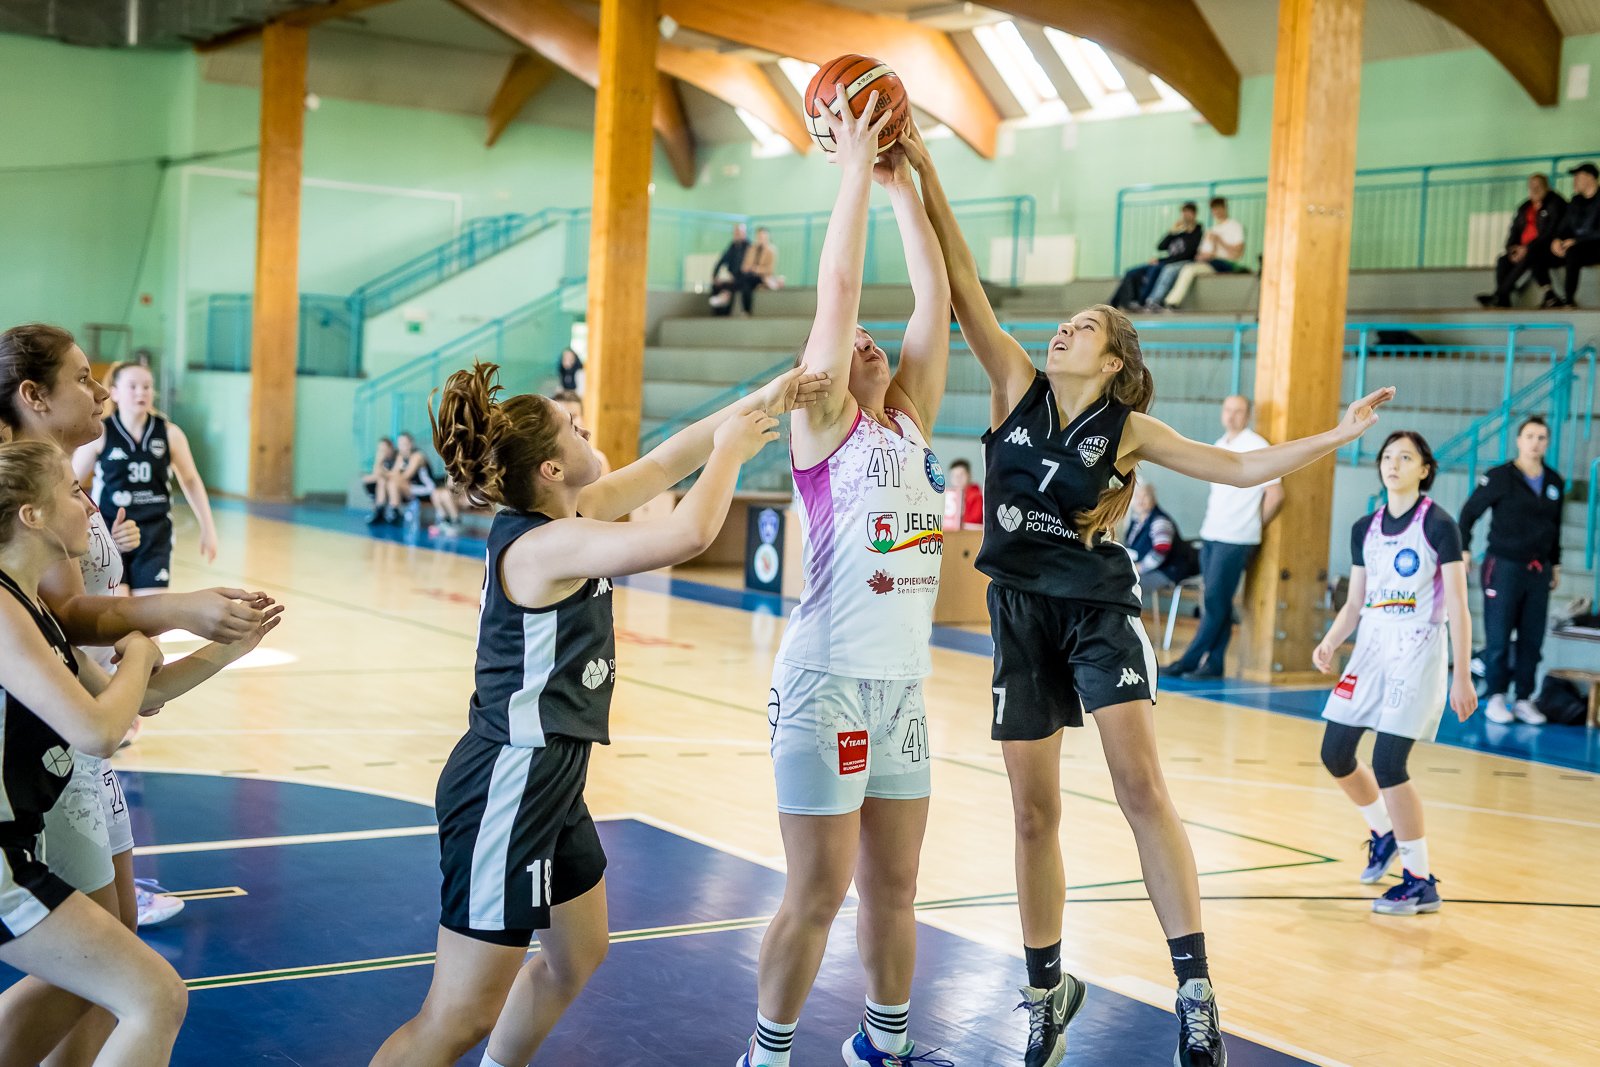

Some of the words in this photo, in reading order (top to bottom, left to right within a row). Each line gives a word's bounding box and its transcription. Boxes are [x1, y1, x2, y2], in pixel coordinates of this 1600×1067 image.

[127, 461, 152, 483] 30
[866, 447, 901, 487] 41
[1037, 458, 1060, 493] 7
[903, 512, 943, 533] JELENI
[1026, 510, 1063, 527] GMINA
[918, 532, 943, 556] GÓR
[992, 687, 1007, 725] 7
[901, 715, 930, 763] 41
[526, 858, 552, 908] 18
